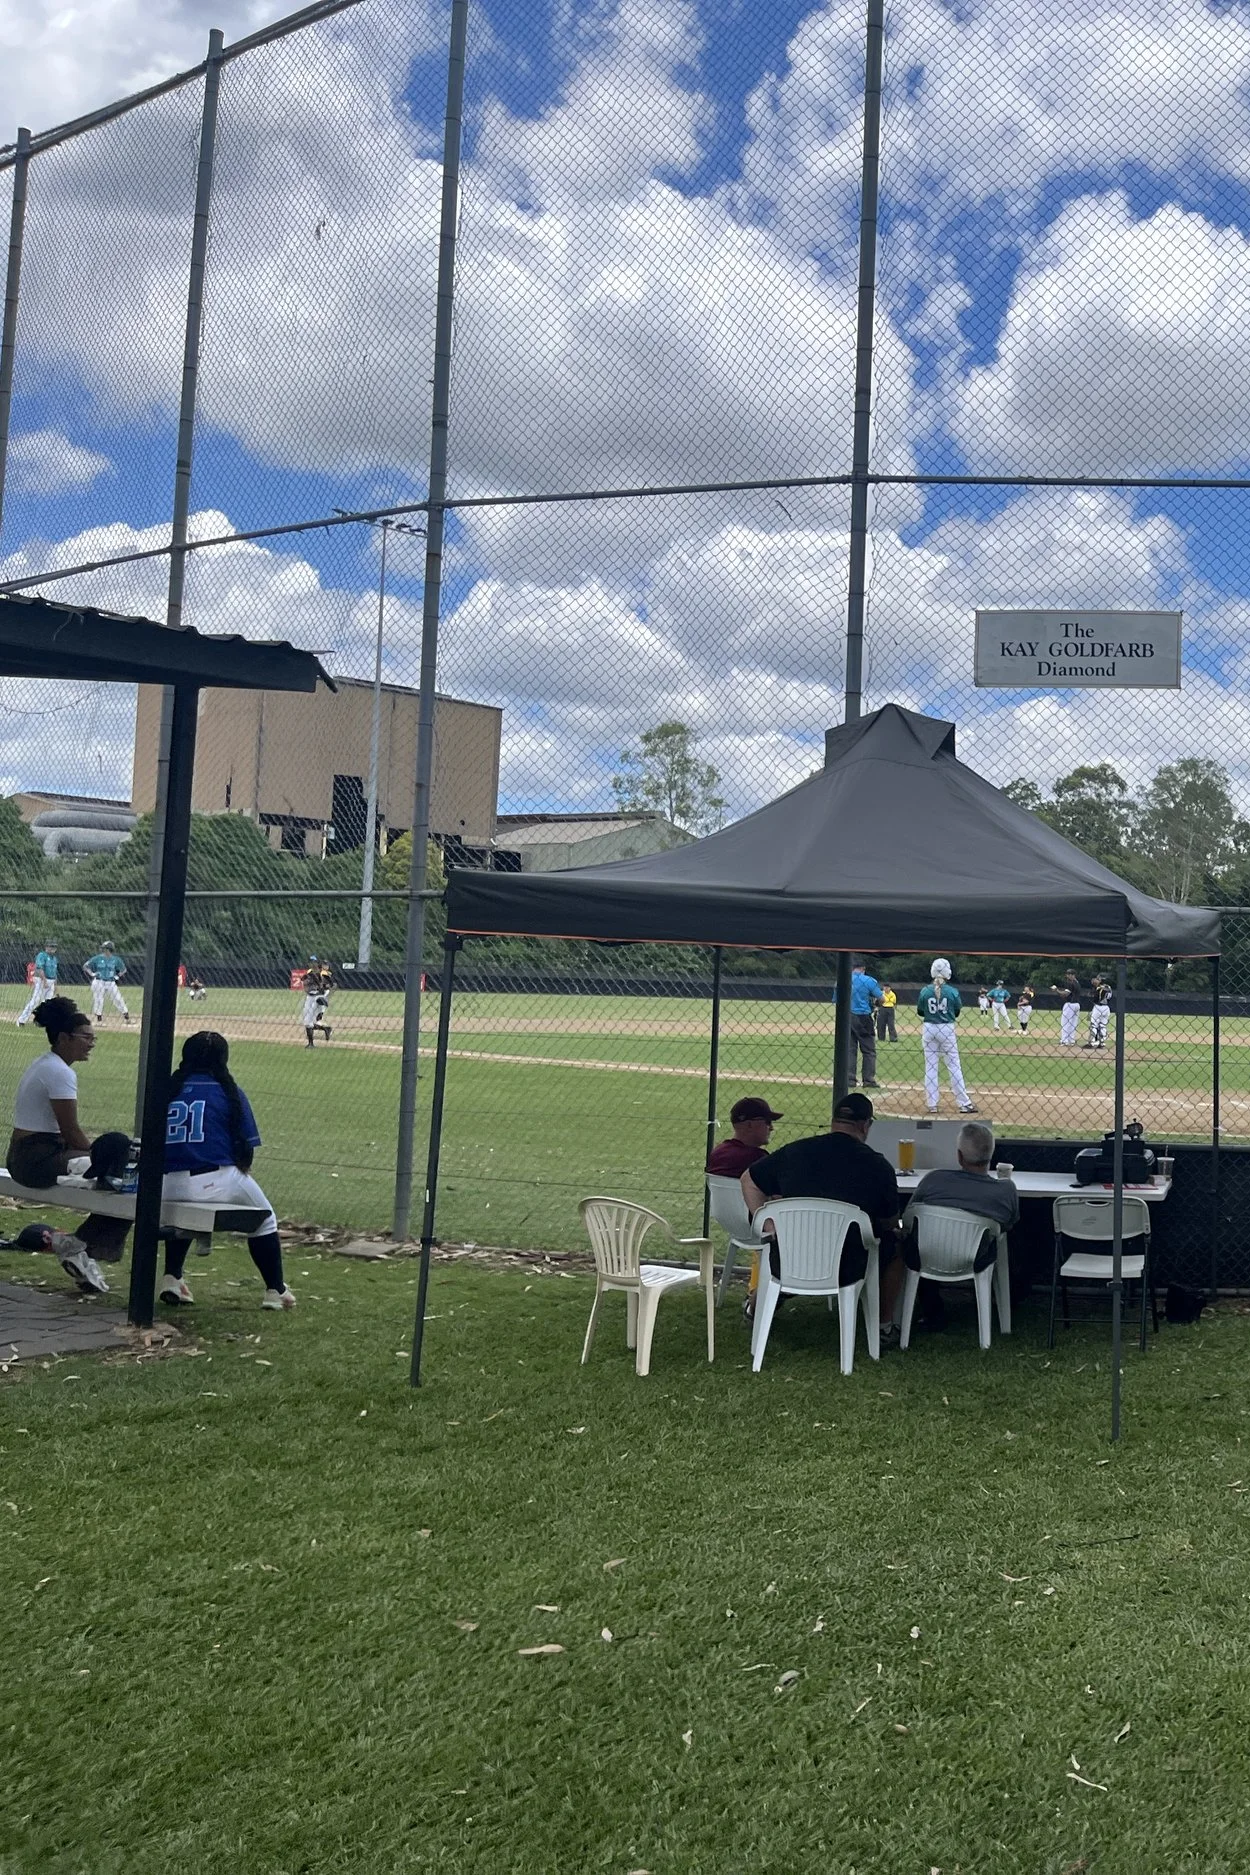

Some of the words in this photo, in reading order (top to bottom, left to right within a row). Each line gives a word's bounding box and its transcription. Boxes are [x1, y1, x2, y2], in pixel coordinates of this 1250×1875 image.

[1059, 622, 1095, 638] The
[999, 641, 1040, 657] KAY
[1048, 642, 1155, 658] GOLDFARB
[1036, 661, 1116, 677] Diamond
[927, 997, 948, 1014] 64
[165, 1100, 206, 1144] 21
